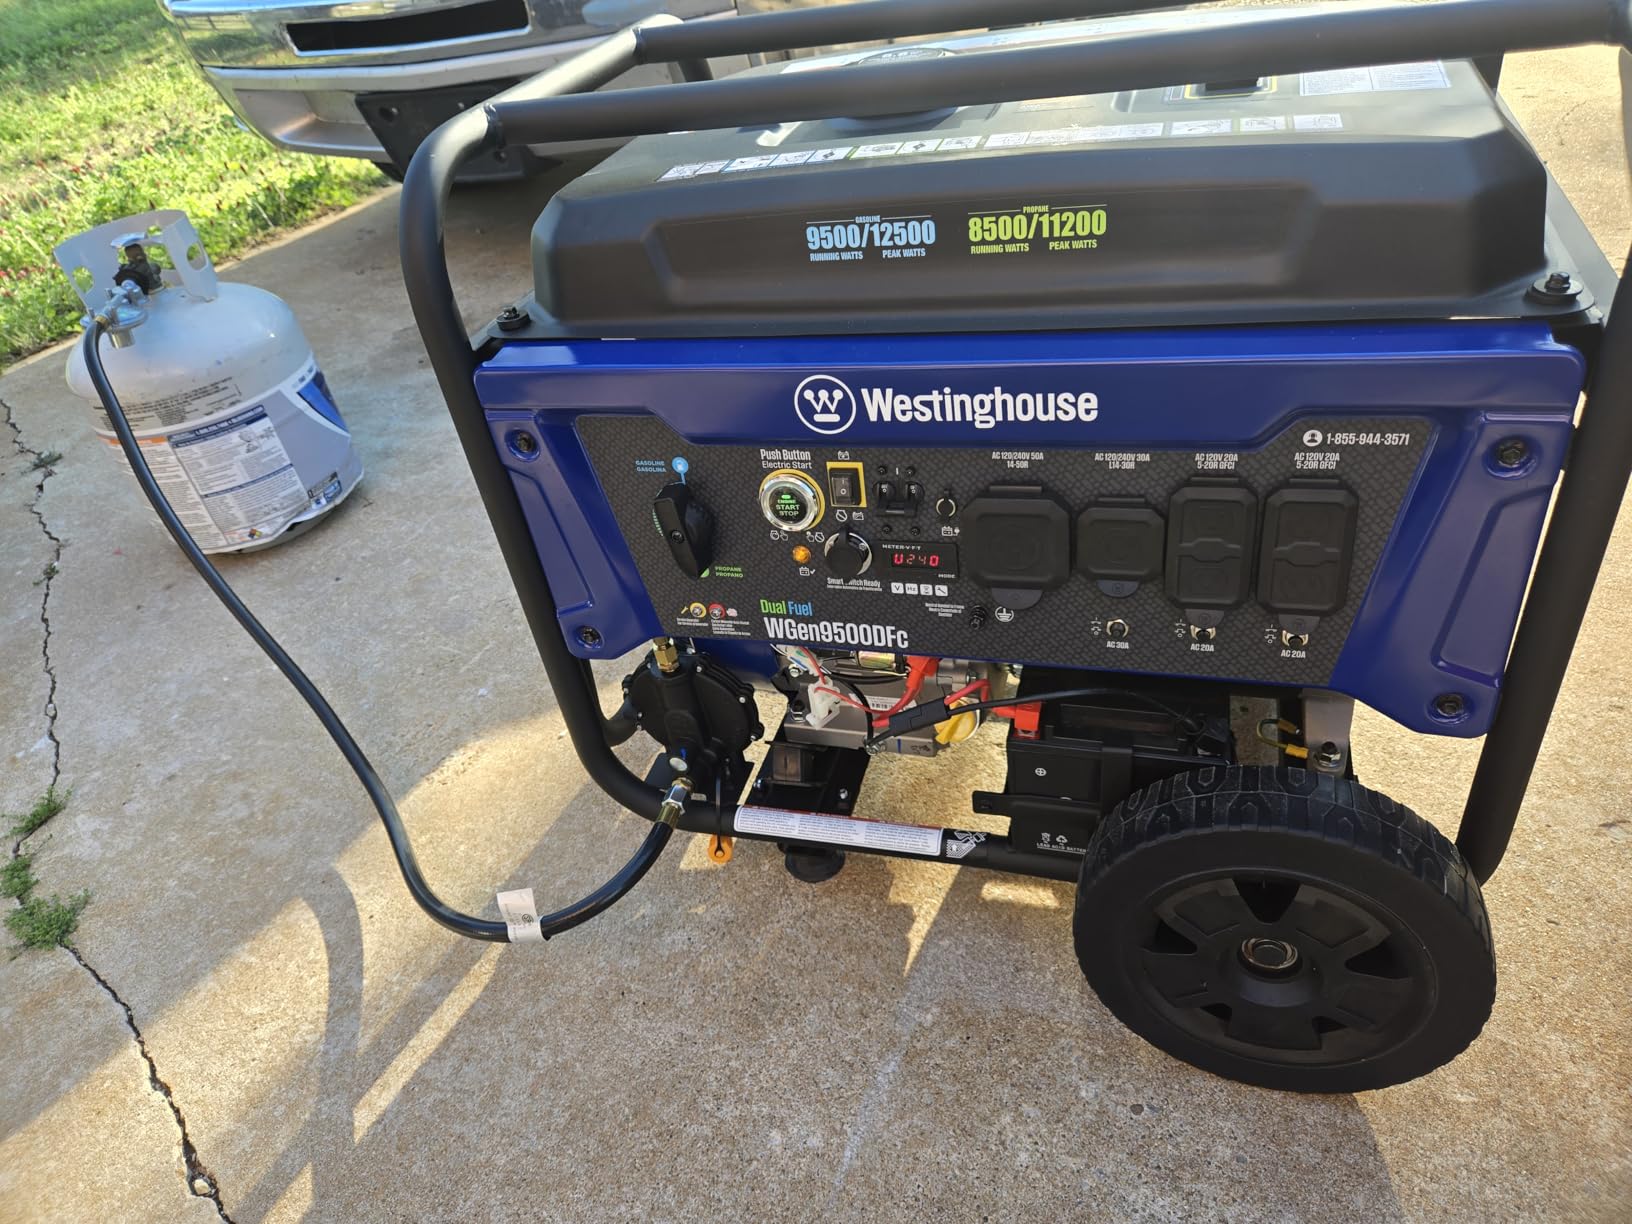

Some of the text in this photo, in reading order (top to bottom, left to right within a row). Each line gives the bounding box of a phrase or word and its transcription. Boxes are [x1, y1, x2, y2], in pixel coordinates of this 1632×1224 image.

[1022, 205, 1049, 214] PROPANE
[855, 215, 880, 224] GASOLINE
[968, 209, 1107, 242] 8500/11200
[806, 219, 936, 250] 9500/12500
[970, 243, 1030, 254] RUNNING WATTS
[1049, 239, 1098, 250] PEAK WATTS
[809, 251, 863, 262] RUNNING WATTS
[882, 248, 926, 259] PEAK WATTS
[860, 386, 1099, 429] Westinghouse
[1326, 432, 1410, 446] 1-855-944-3571
[760, 449, 811, 461] Push Button
[991, 452, 1044, 460] AC 120/240V 50A
[1095, 453, 1150, 462] AC 120/240V 30A
[1195, 453, 1238, 462] AC 120V 20A
[1294, 452, 1340, 462] AC 120V 20A
[762, 461, 812, 470] Electric Start
[1197, 461, 1235, 470] 5-20R GFCI
[1296, 461, 1336, 470] 5-20R GFCI
[864, 580, 881, 588] Ready
[760, 599, 813, 617] Dual Fuel
[763, 616, 909, 649] WGen9500DFc
[1106, 641, 1130, 650] AC 30A
[1190, 643, 1215, 652] AC 20A
[1281, 649, 1306, 658] AC 20A
